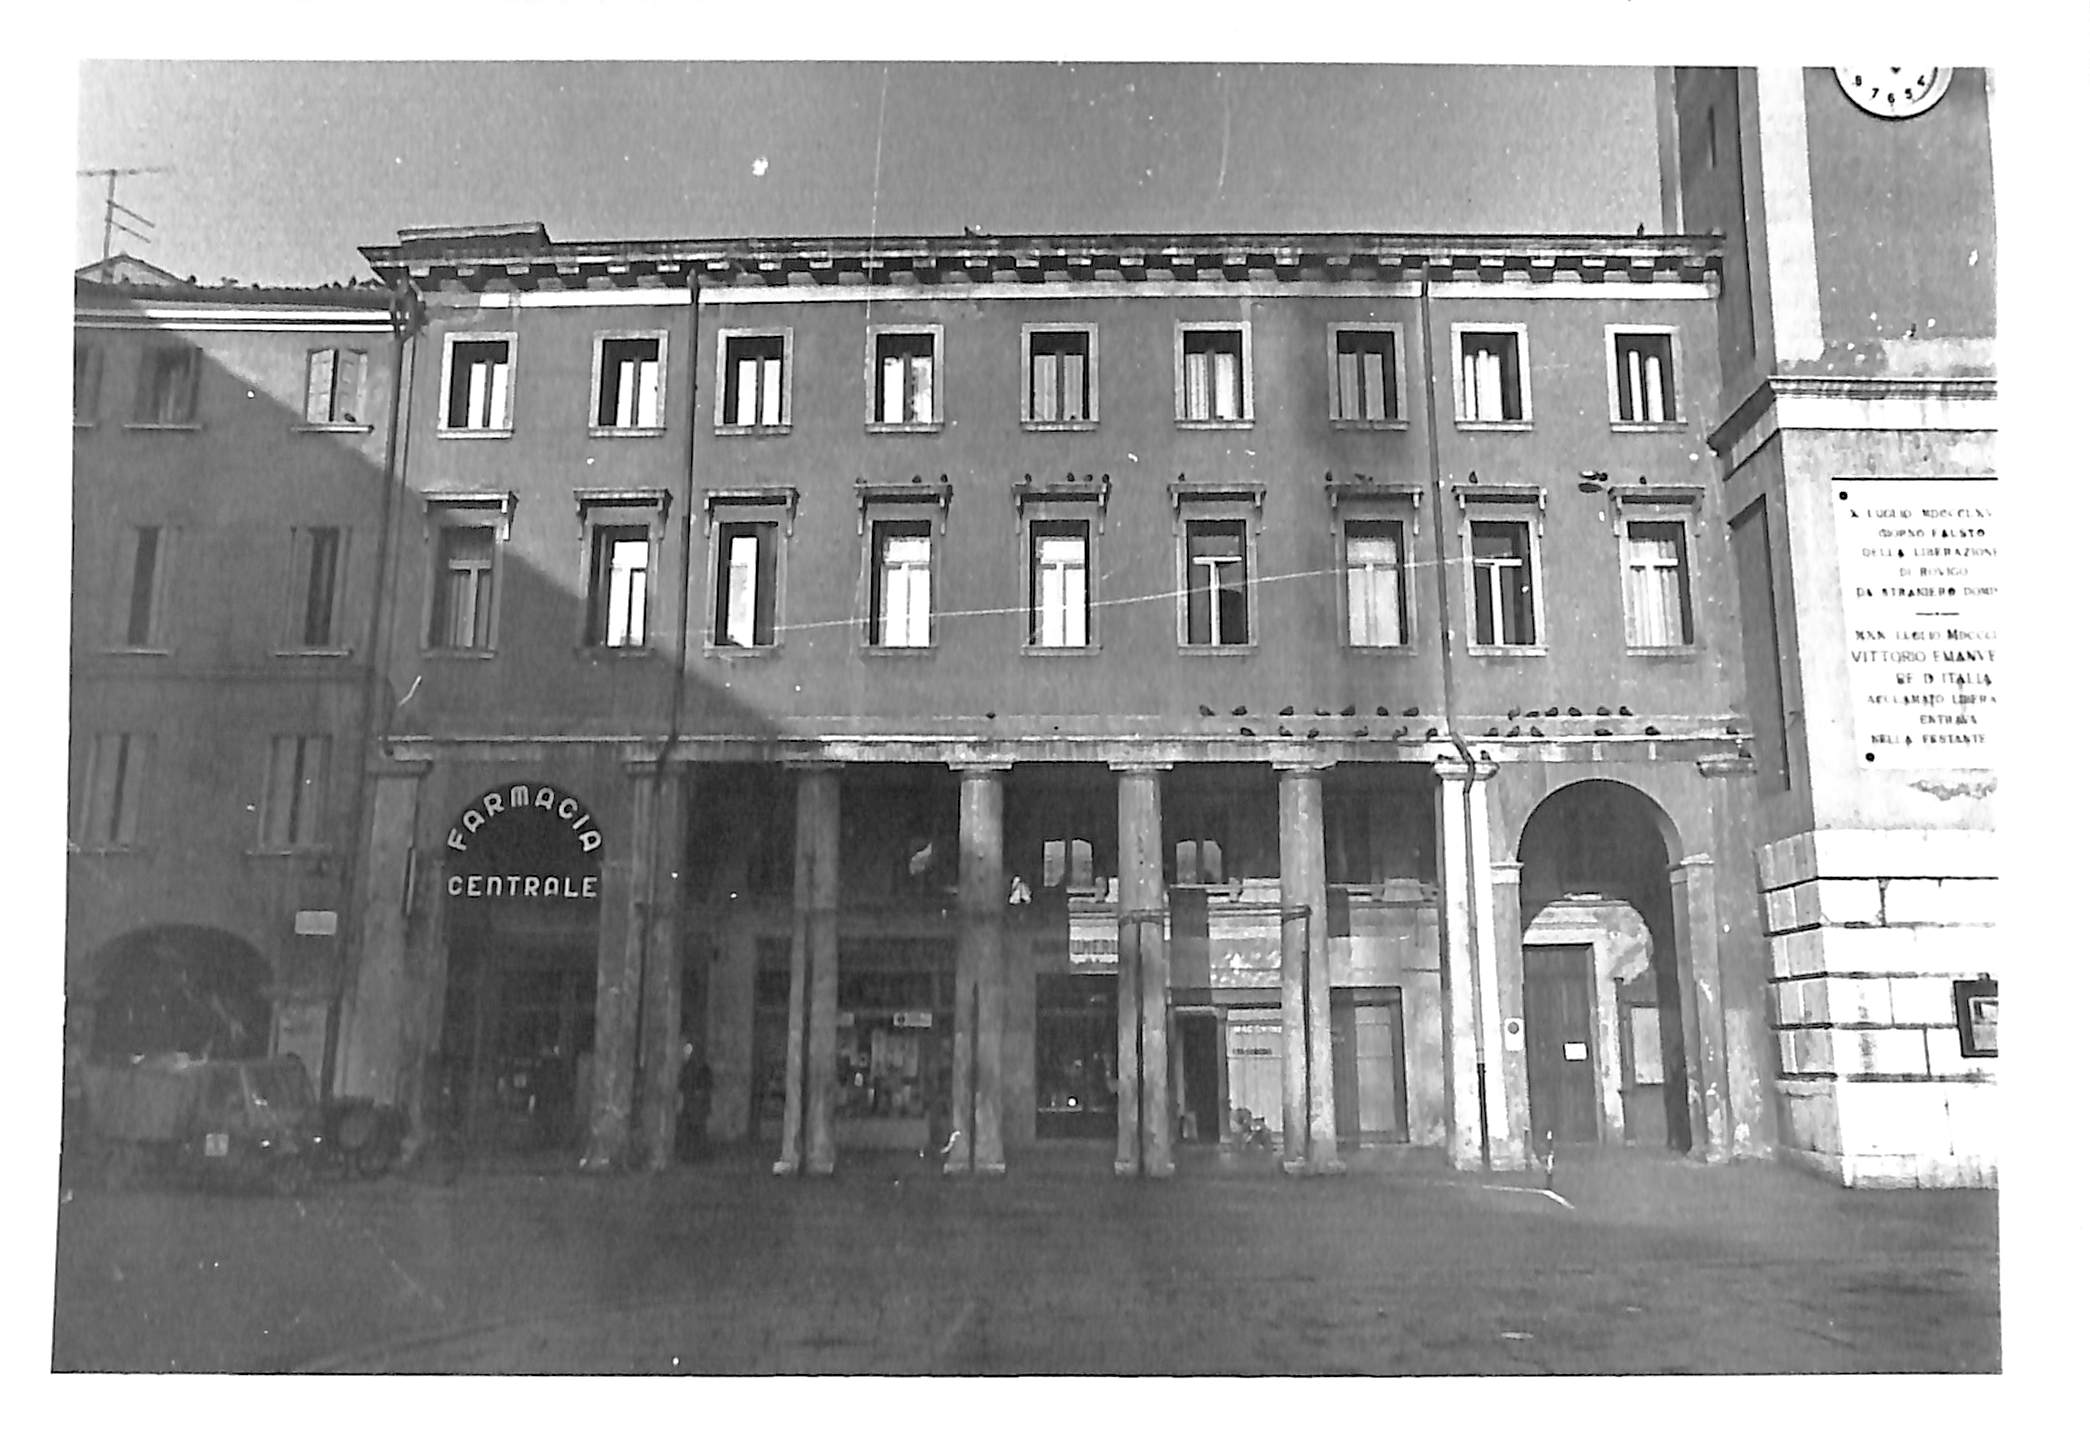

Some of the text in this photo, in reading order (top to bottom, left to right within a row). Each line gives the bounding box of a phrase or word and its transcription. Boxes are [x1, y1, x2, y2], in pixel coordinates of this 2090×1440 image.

[1917, 75, 1925, 87] 4
[1871, 87, 1880, 99] 7
[1887, 92, 1895, 104] 6
[1904, 88, 1913, 100] 5
[1878, 528, 1925, 539] GIORNO
[1861, 547, 1905, 558] DELLA
[1899, 566, 1969, 578] DI ROVIGO
[1856, 587, 1874, 598] DA
[1850, 650, 1927, 663] VITTORIO
[1922, 734, 1987, 745] FESTANTE
[447, 785, 602, 852] FARMACIA
[448, 875, 598, 898] CENTRALE
